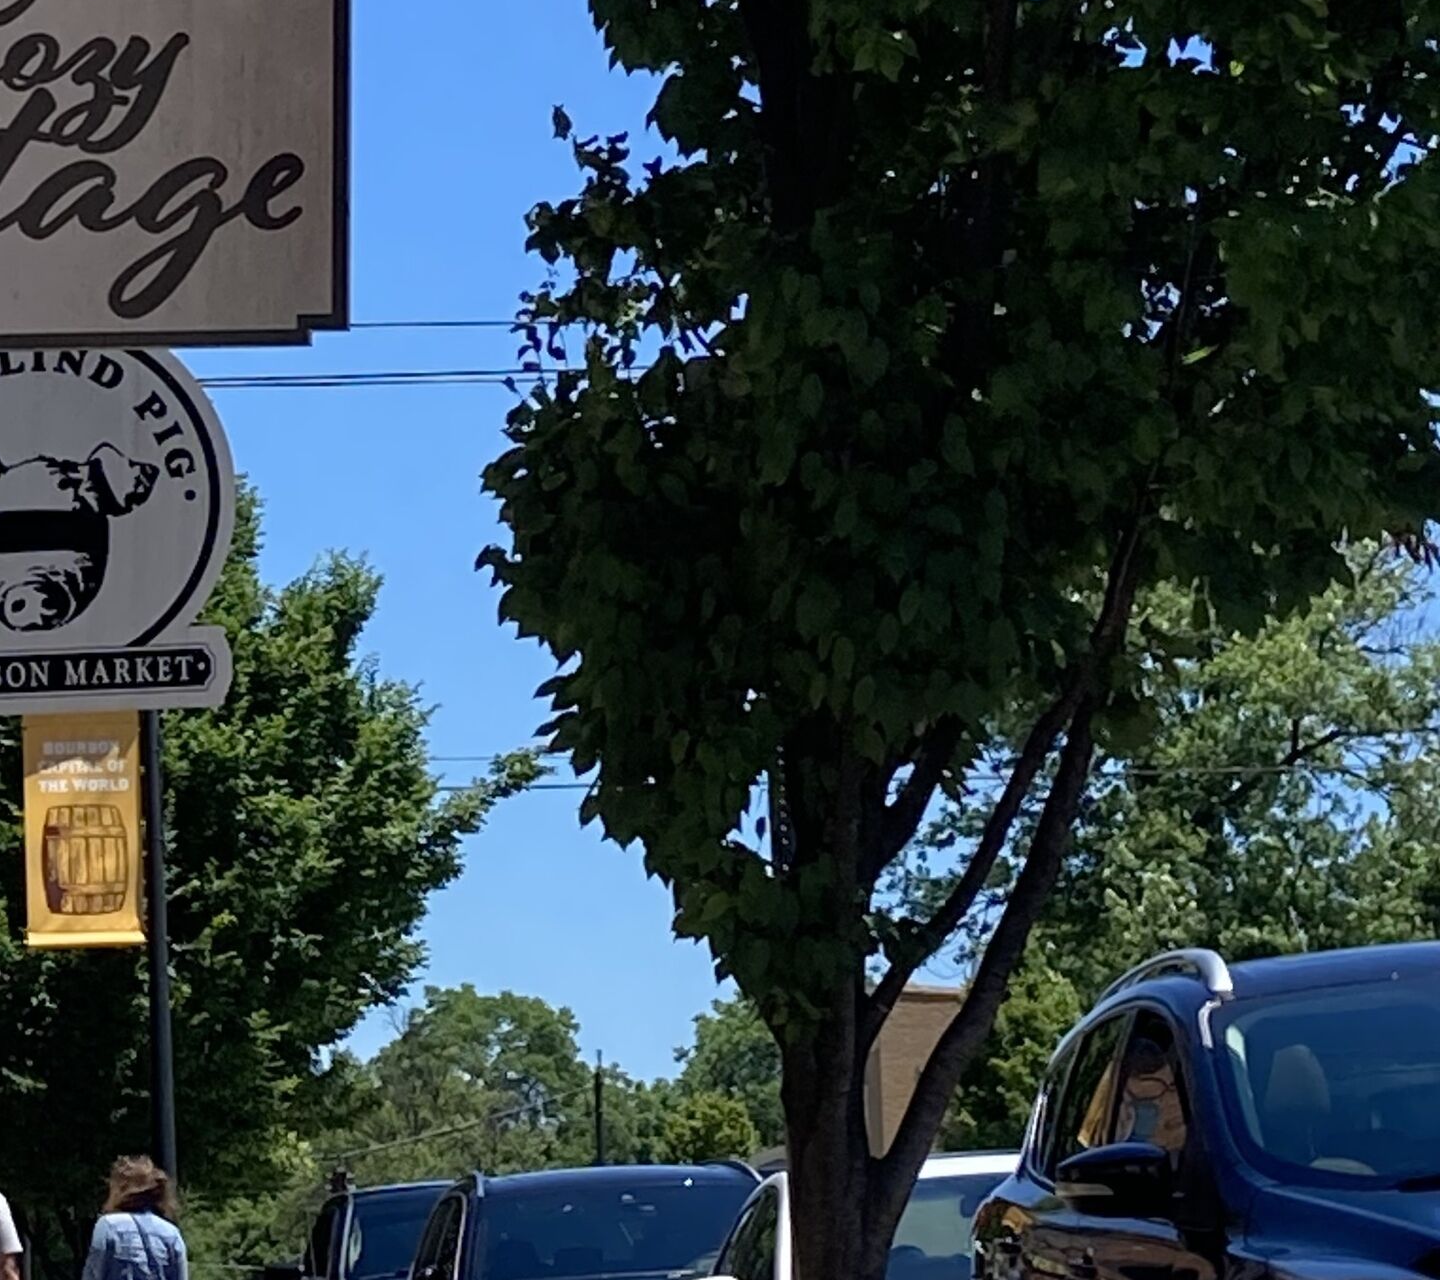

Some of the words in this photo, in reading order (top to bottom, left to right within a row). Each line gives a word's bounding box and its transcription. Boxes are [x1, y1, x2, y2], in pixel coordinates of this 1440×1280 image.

[133, 391, 197, 480] PIG
[64, 654, 194, 687] MARKET
[43, 740, 119, 755] BOURBON
[107, 758, 127, 773] OF
[38, 778, 69, 794] THE
[71, 777, 129, 793] WORLD
